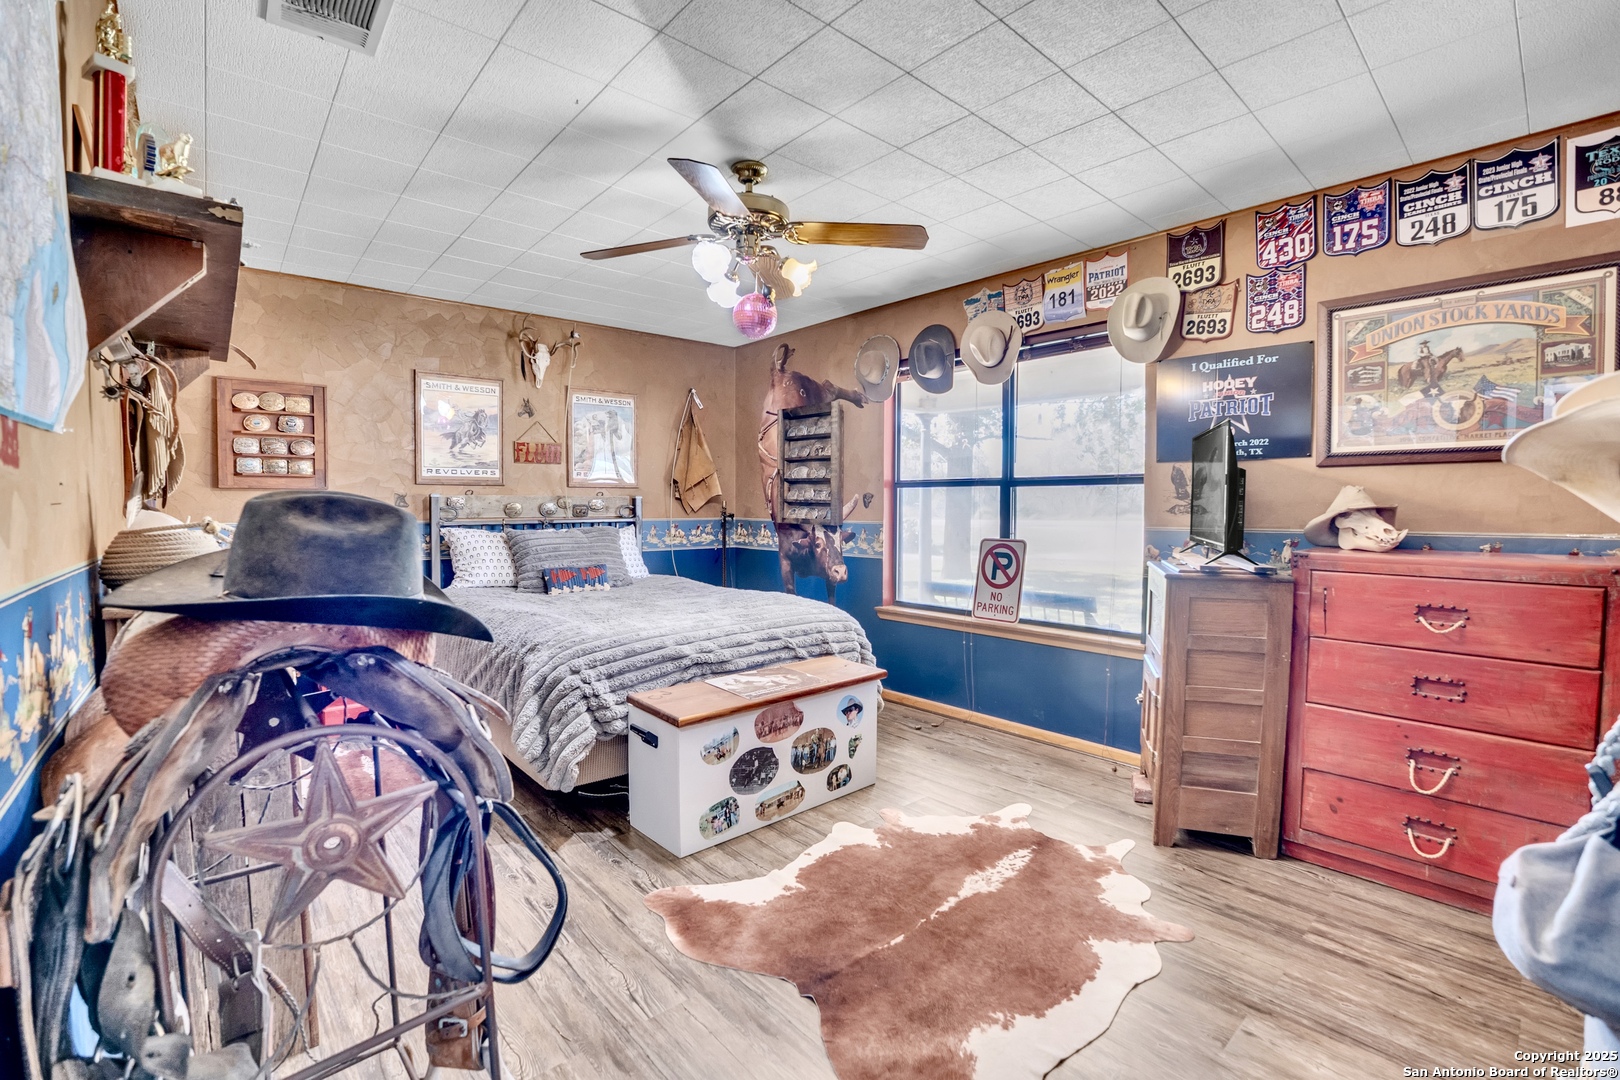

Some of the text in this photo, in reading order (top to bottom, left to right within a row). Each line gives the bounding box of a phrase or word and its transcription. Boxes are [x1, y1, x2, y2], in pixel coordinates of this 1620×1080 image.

[1478, 171, 1554, 197] CINCH
[1402, 190, 1464, 213] CINCH
[1598, 187, 1620, 206] 8
[1331, 211, 1360, 222] CINCH
[1493, 193, 1538, 223] 175
[1332, 217, 1379, 252] 175
[1410, 212, 1456, 242] 248
[1262, 232, 1311, 265] 430
[1088, 264, 1126, 283] PATRIOT
[1172, 264, 1216, 288] 2693
[1049, 288, 1075, 309] 181
[1090, 284, 1124, 301] 2022
[1013, 310, 1040, 329] 693
[1251, 299, 1299, 330] 248
[1185, 318, 1228, 336] 2693
[1370, 313, 1426, 348] UNION
[1429, 303, 1488, 327] STOCK
[1493, 302, 1562, 324] YARDS
[1191, 353, 1279, 373] I Qualified For
[425, 381, 453, 391] SMITH
[462, 385, 497, 395] WESSON
[1202, 376, 1258, 393] HOOEY
[575, 395, 597, 403] SMITH
[604, 397, 632, 406] WESSON
[1188, 392, 1275, 422] PATRIOT
[1248, 447, 1264, 456] TX
[1249, 438, 1269, 446] 2022
[426, 468, 497, 477] REVOLVERS
[990, 591, 1003, 602] NO
[976, 602, 1015, 616] PARKING
